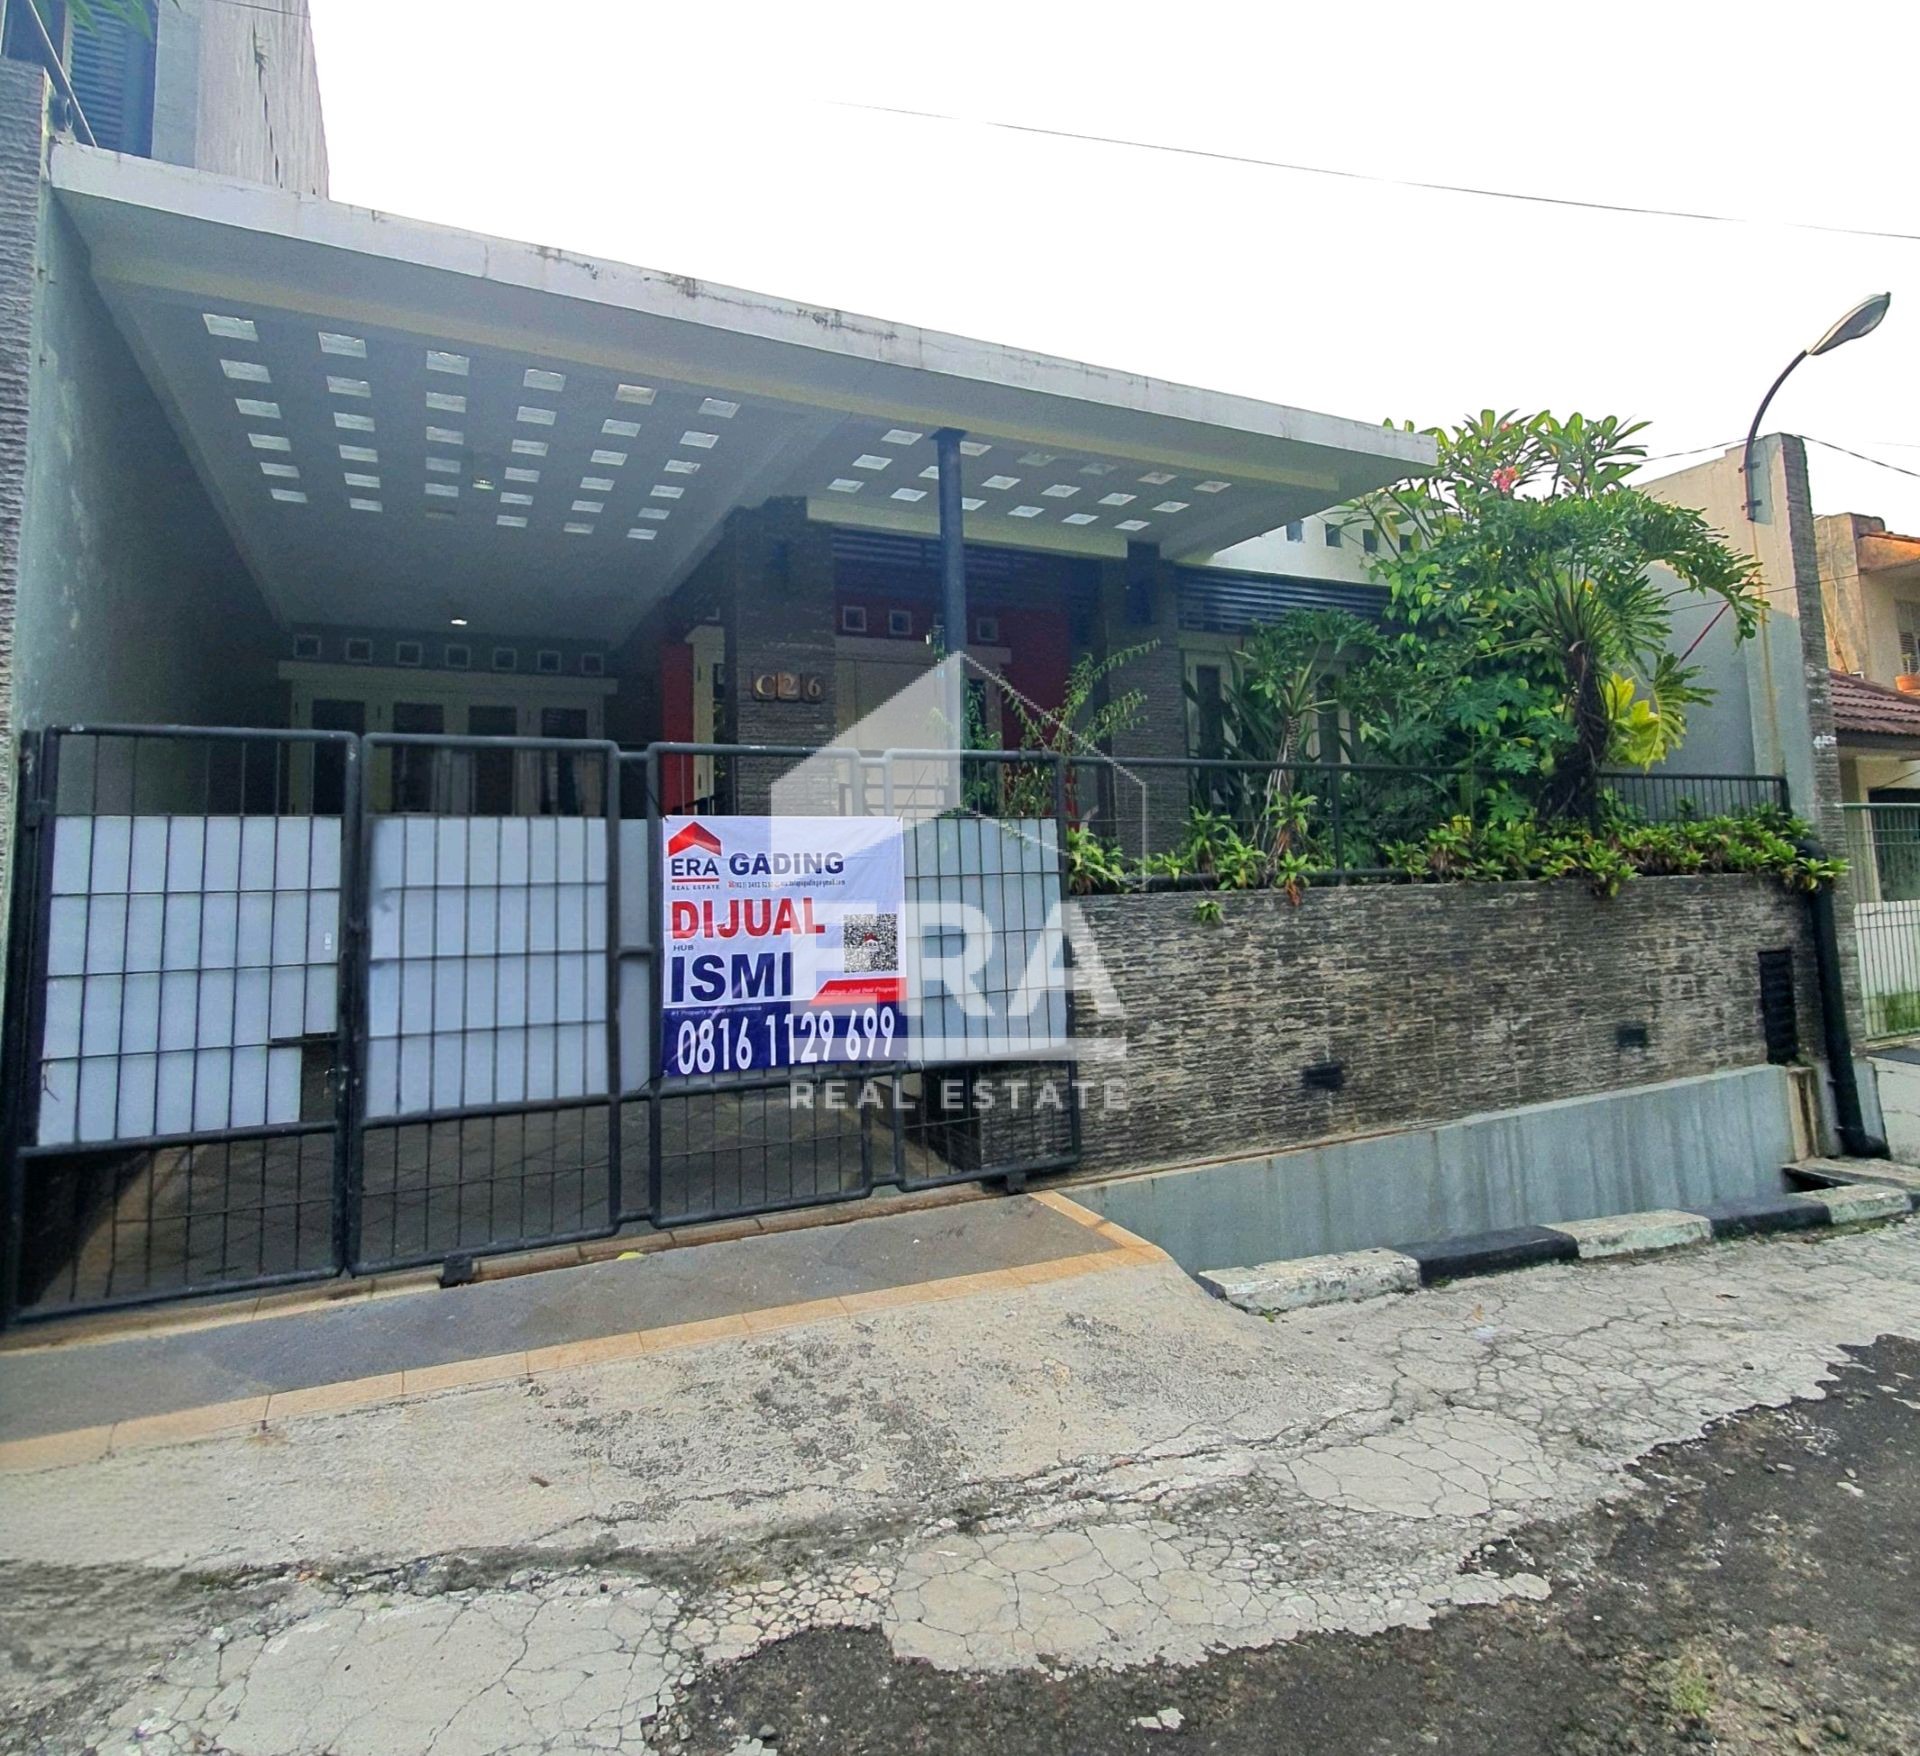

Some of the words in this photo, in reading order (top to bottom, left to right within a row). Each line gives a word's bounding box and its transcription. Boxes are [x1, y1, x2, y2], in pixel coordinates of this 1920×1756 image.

[671, 858, 719, 877] ERA
[729, 851, 844, 876] GADING
[672, 897, 826, 939] DIJUAL
[671, 952, 794, 1003] ISMI
[677, 1017, 753, 1075] 0816
[765, 1010, 834, 1066] 1129
[845, 1006, 896, 1060] 699
